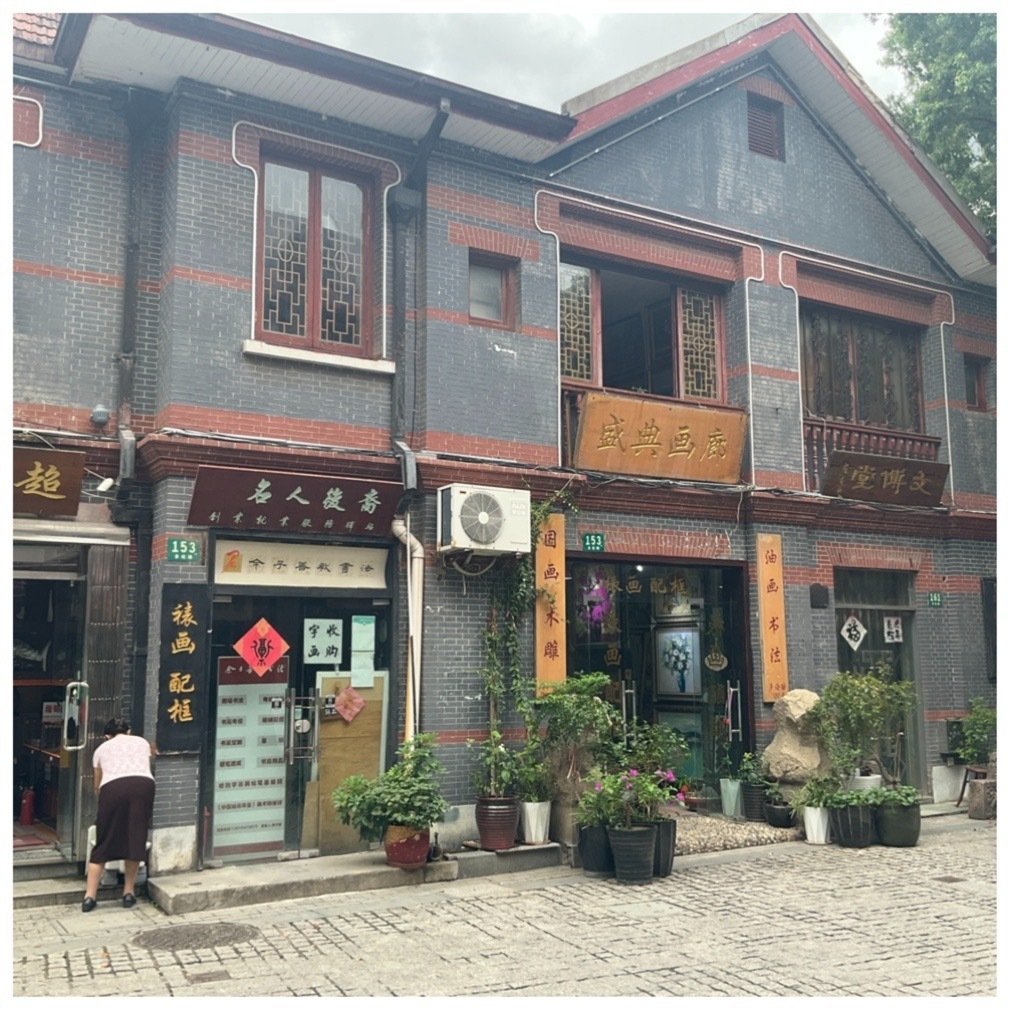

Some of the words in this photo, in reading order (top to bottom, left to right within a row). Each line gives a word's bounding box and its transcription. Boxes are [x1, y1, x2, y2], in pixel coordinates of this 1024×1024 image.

[597, 412, 728, 462] 盛典画廊
[14, 461, 67, 500] 超
[172, 540, 196, 554] 153
[585, 535, 602, 546] 153
[765, 550, 782, 664] 油画书法
[929, 593, 942, 602] 161
